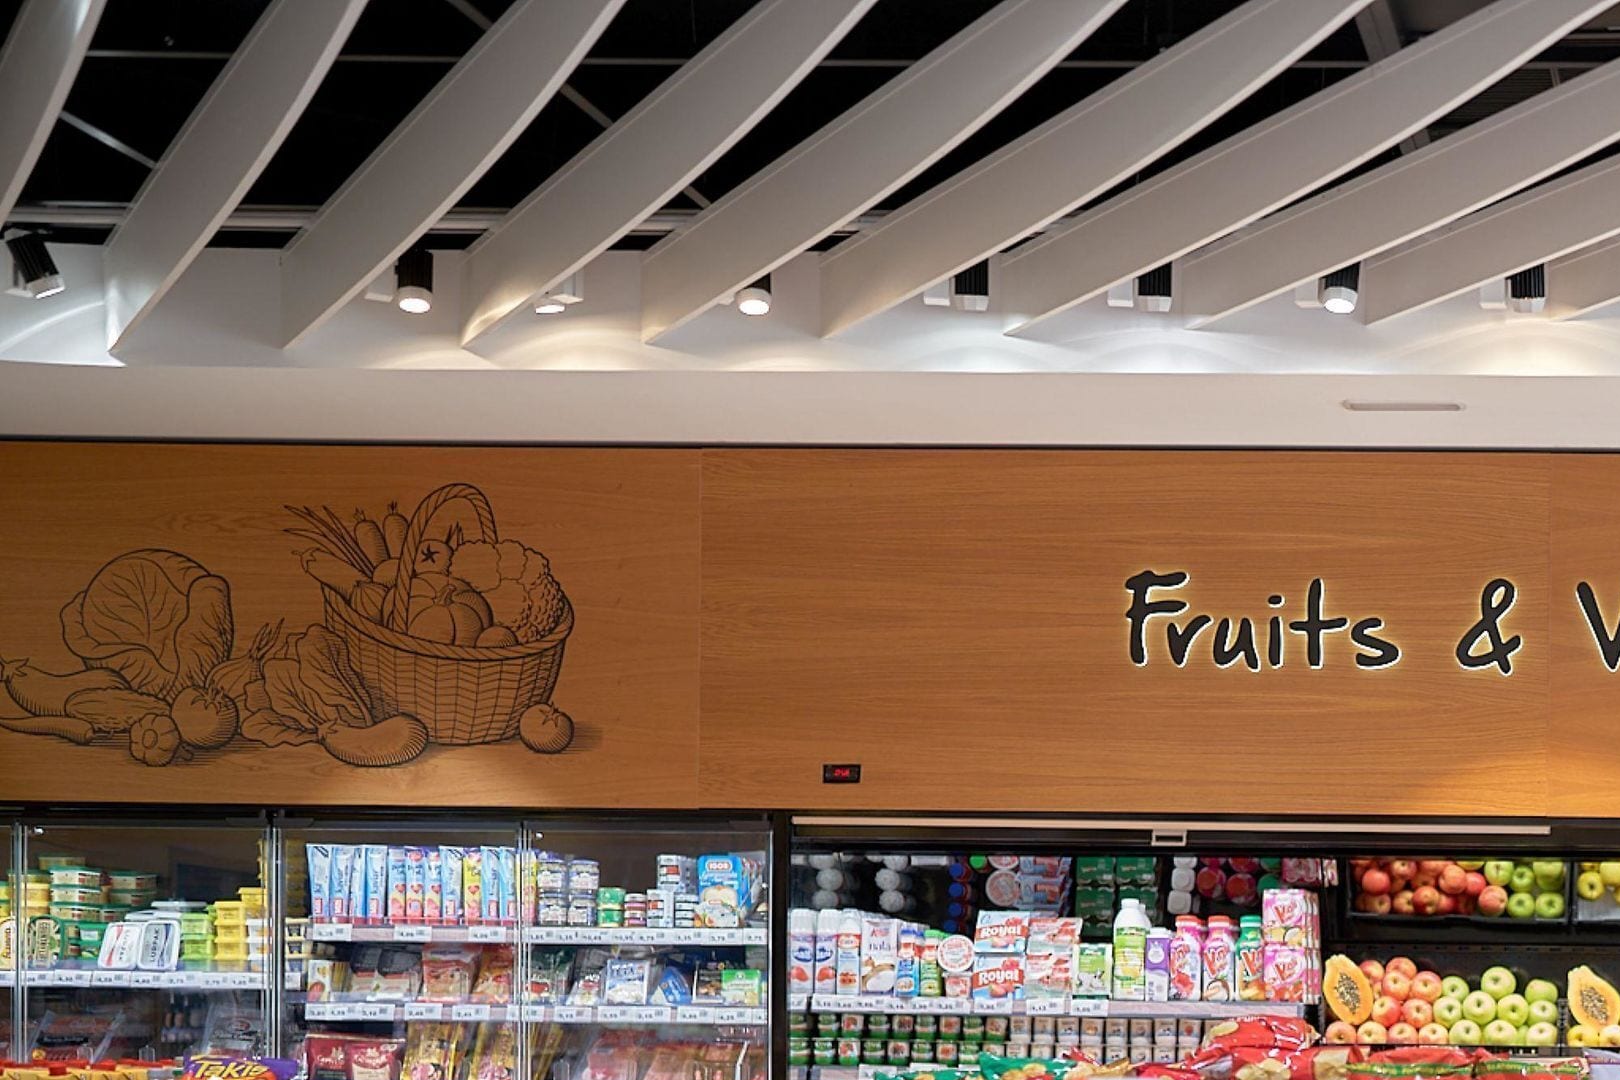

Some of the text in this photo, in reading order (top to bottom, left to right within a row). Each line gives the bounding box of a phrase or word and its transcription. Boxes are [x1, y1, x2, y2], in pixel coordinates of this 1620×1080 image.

[1124, 569, 1401, 673] Fruits
[1455, 577, 1522, 676] &
[980, 924, 1022, 938] Royal
[978, 969, 1020, 986] Royal
[196, 1060, 270, 1079] Takis
